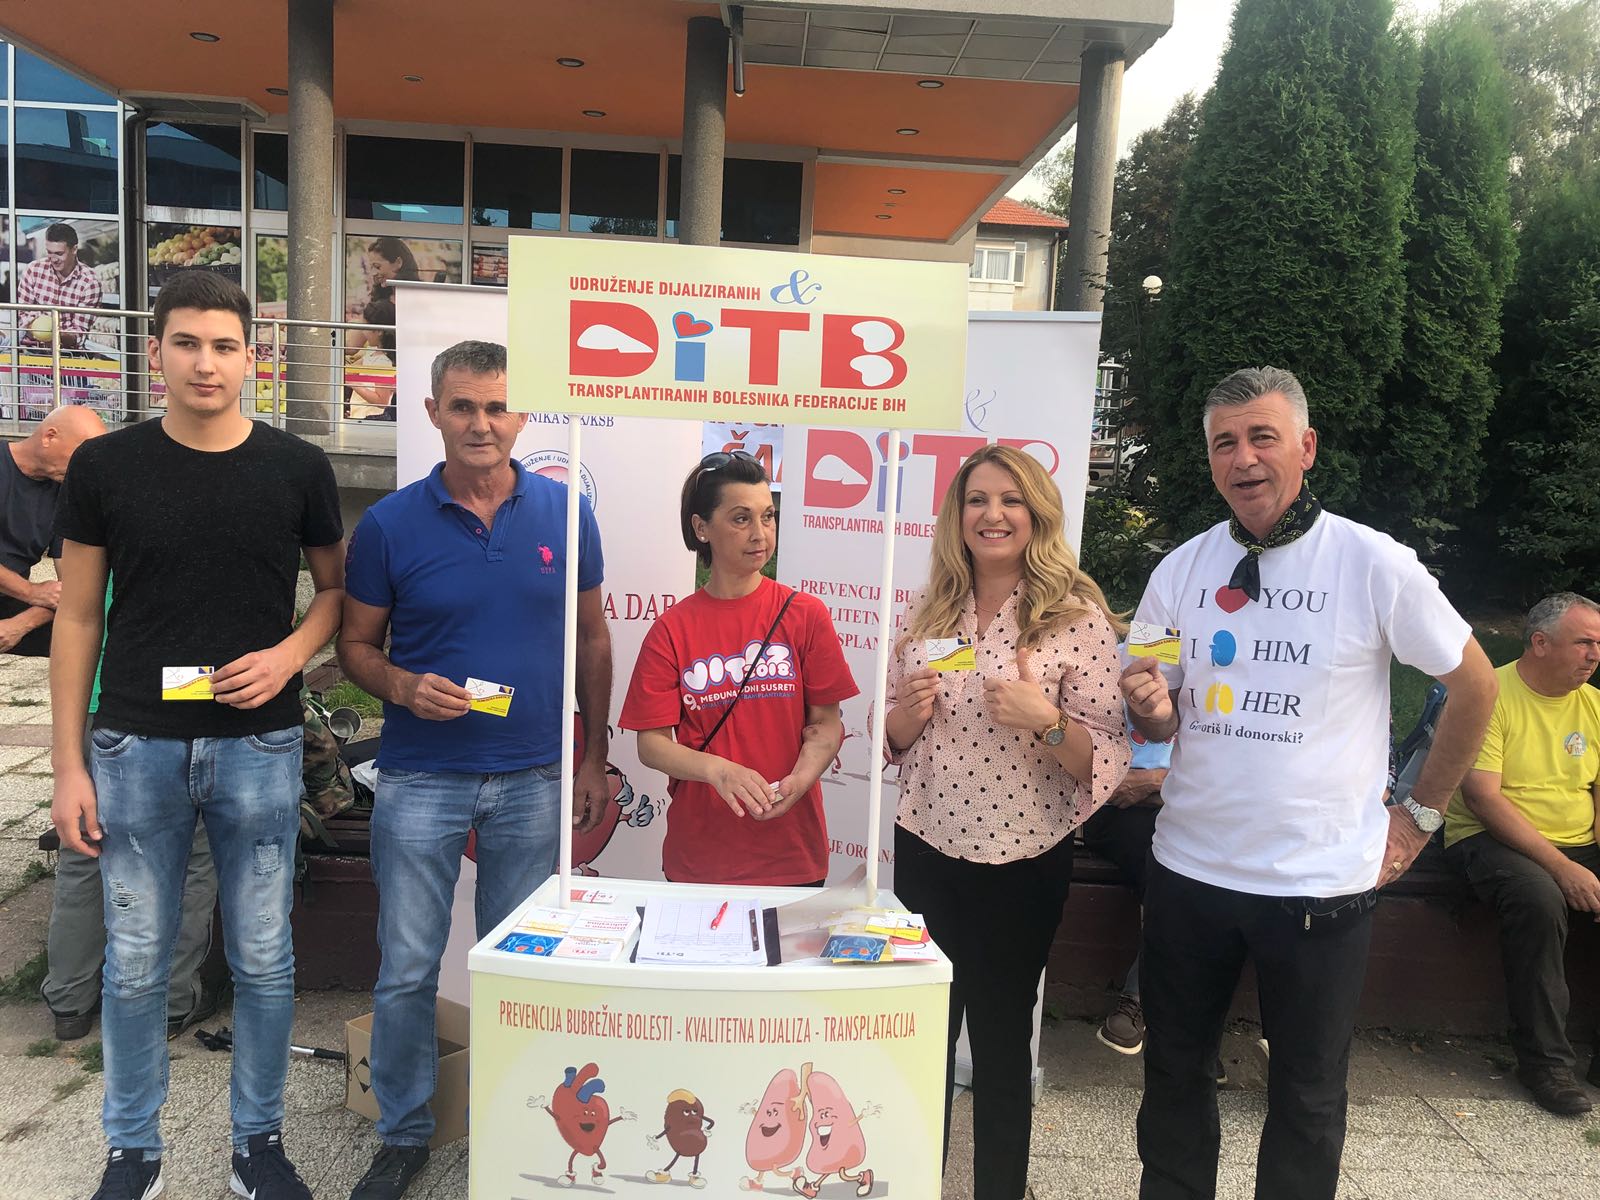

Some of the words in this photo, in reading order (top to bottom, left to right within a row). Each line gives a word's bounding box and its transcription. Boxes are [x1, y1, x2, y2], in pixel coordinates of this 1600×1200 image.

[570, 275, 654, 295] UDRUŽENJE
[659, 281, 761, 301] DIJALIZIRANIH
[770, 269, 822, 305] &
[568, 383, 708, 403] TRANSPLANTIRANIH
[713, 390, 790, 408] BOLESNIKA
[794, 394, 878, 411] FEDERACIJE
[883, 398, 907, 412] BIH
[528, 412, 560, 425] NIKA
[803, 514, 901, 536] TRANSPLANTIRAH
[904, 522, 936, 539] BOLES
[800, 579, 881, 601] PREVENCIJ
[1196, 588, 1208, 609] I
[1260, 588, 1329, 613] YOU
[829, 607, 880, 627] LITETN
[1190, 638, 1198, 659] I
[1251, 639, 1312, 665] HIM
[700, 684, 760, 704] MEĐUNADNI
[761, 683, 796, 692] SUSRETI
[1189, 688, 1197, 709] I
[1240, 690, 1302, 718] HER
[1224, 723, 1232, 736] li
[1235, 725, 1304, 744] donorski?
[499, 1000, 563, 1033] PREVENCIJA
[566, 1004, 623, 1039] BUBREŽNE
[627, 1013, 673, 1042] BOLESTI
[685, 1015, 755, 1044] KVALITETNA
[759, 1016, 812, 1044] DIJALIZA
[823, 1011, 917, 1043] TRANSPLATACIJA
